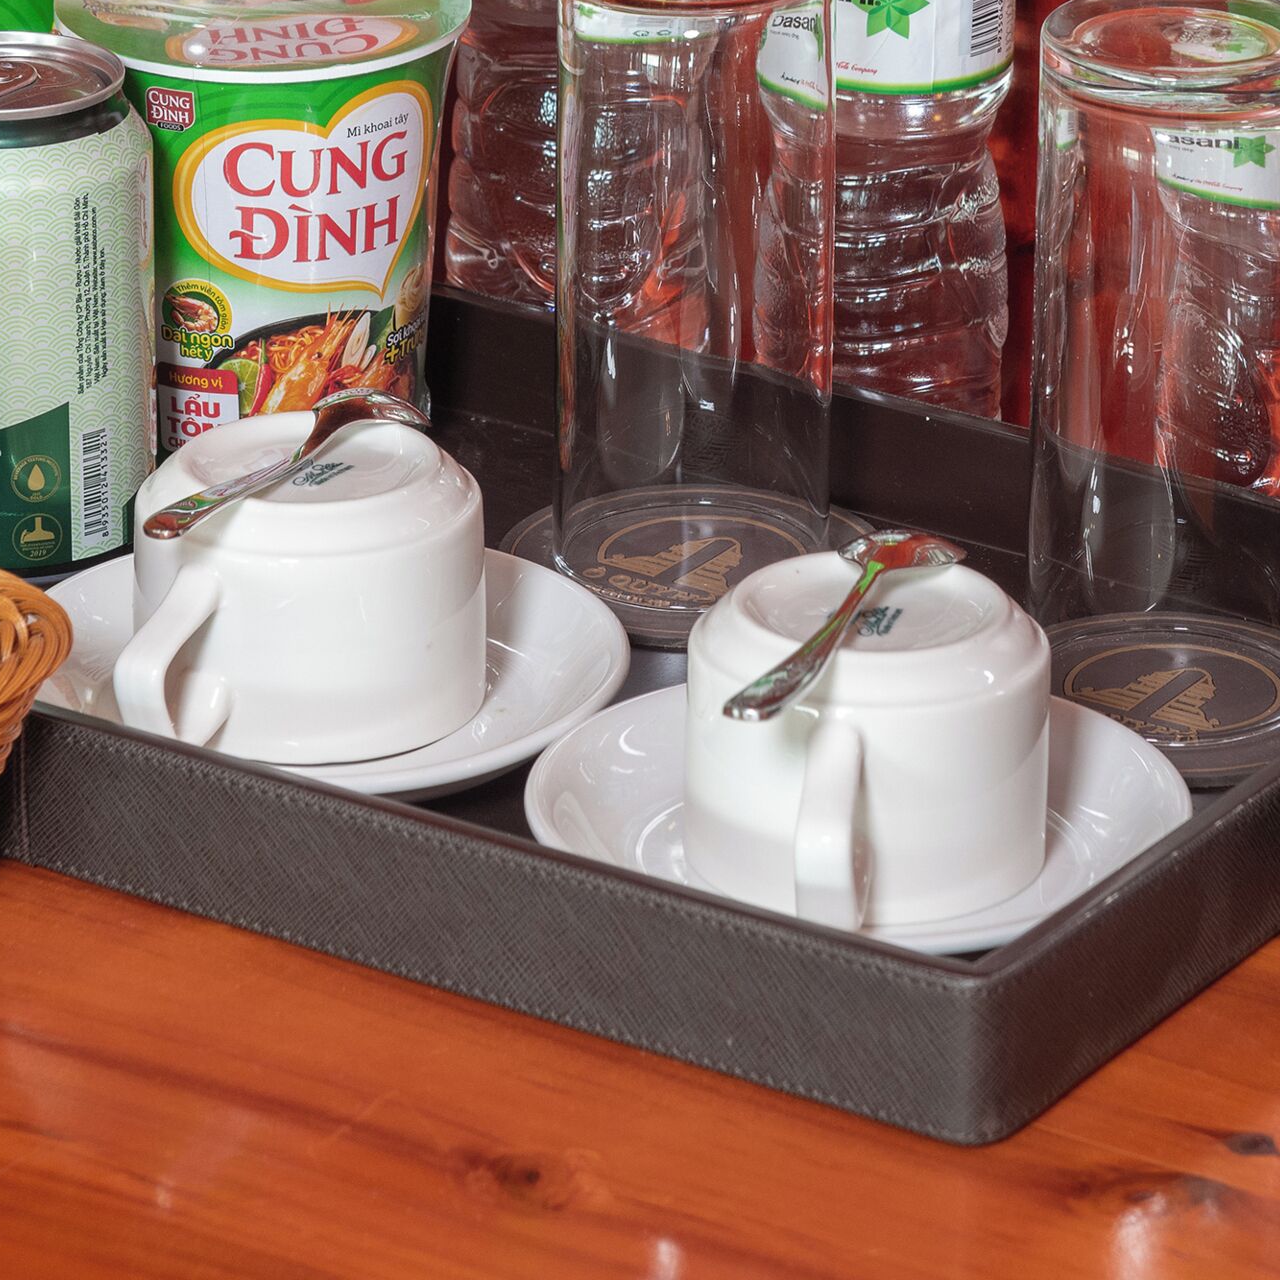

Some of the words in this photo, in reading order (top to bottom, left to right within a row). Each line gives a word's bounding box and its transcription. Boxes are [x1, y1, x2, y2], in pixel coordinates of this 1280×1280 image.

[207, 34, 380, 61] CUNG
[148, 90, 190, 109] CUNG
[150, 104, 189, 124] ĐÌNH
[160, 122, 180, 130] FOODS
[346, 125, 361, 138] Mì
[364, 116, 392, 135] khoai
[394, 113, 409, 125] tây
[222, 129, 409, 198] CUNG
[228, 194, 401, 264] ĐÌNH
[176, 282, 199, 292] Thêm
[200, 285, 216, 298] viên
[214, 295, 226, 313] tôm
[76, 304, 82, 314] CP
[76, 320, 84, 337] Công
[75, 337, 84, 353] Tổng
[190, 332, 233, 348] ngon
[181, 344, 203, 358] hết
[203, 346, 213, 361] ý
[169, 370, 209, 389] Hương
[210, 376, 224, 390] vị
[171, 393, 220, 418] LẨU
[167, 416, 214, 437] TÔ
[30, 549, 47, 558] 2019
